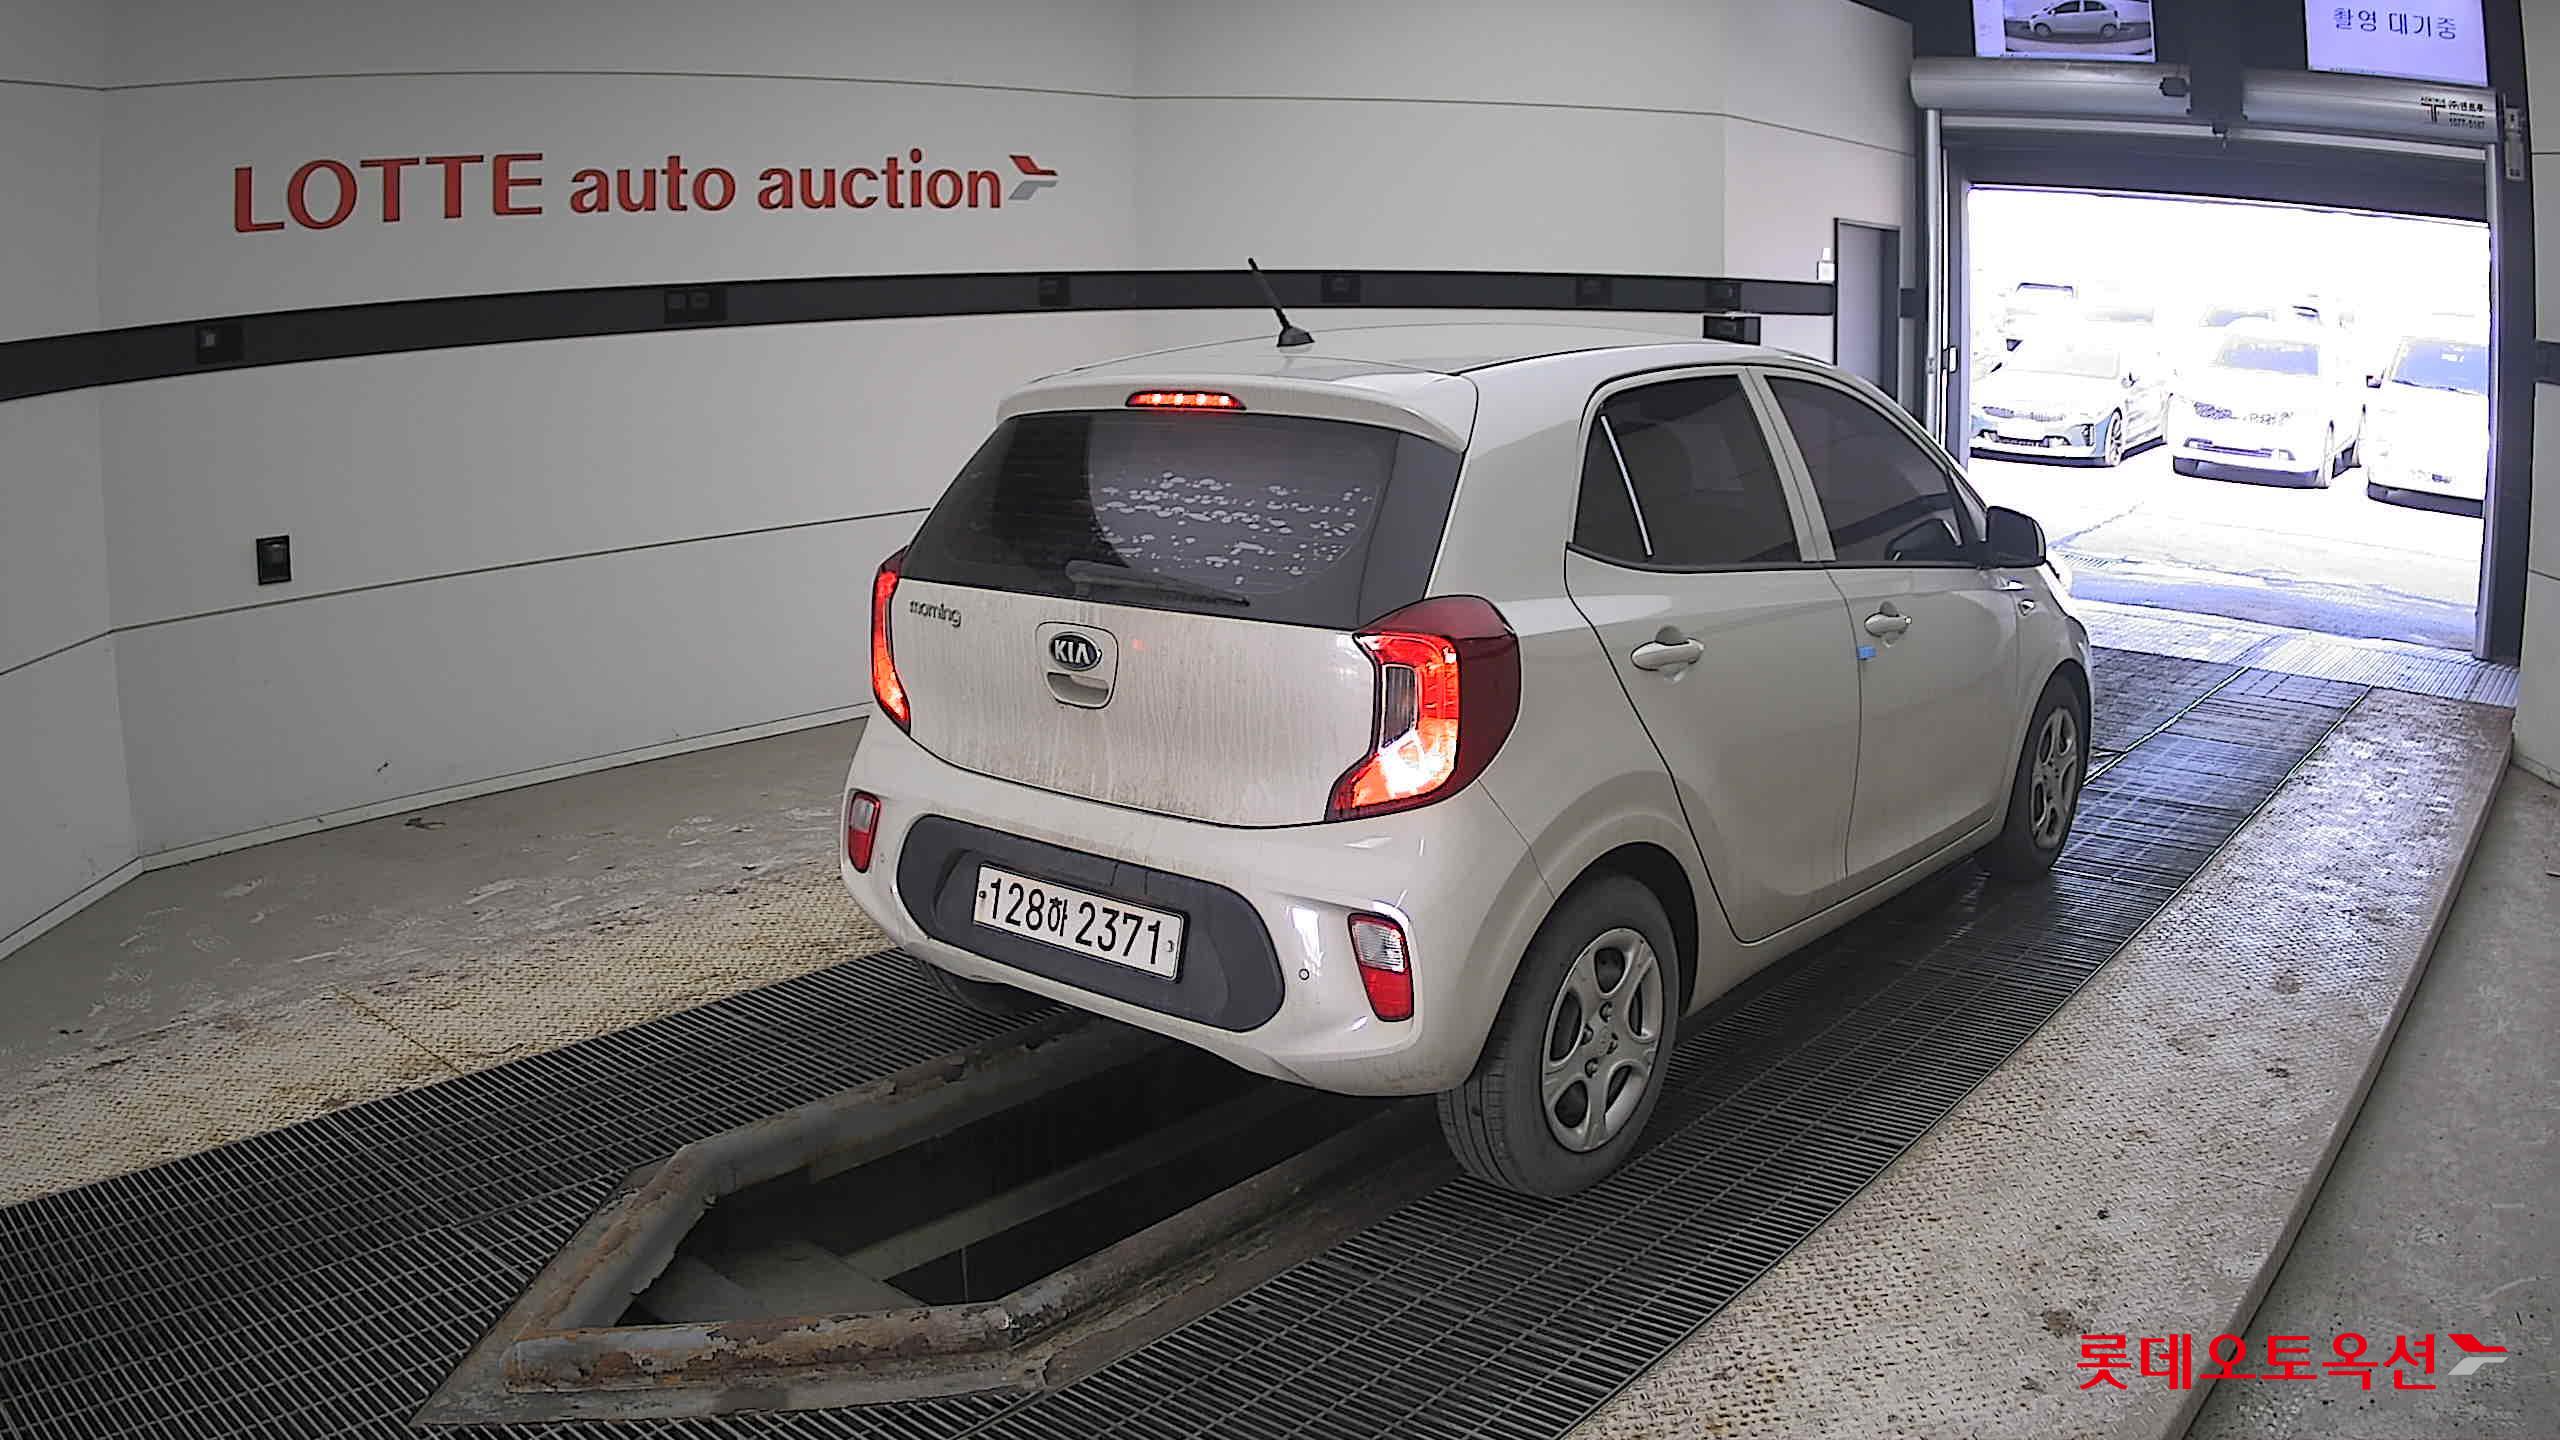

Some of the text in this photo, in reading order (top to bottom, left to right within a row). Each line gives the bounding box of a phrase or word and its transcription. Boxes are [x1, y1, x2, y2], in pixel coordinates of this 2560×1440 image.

[2333, 7, 2457, 40] 촬영 대기중
[235, 147, 1003, 233] LOTTE auto auction
[910, 601, 962, 628] morning
[1054, 639, 1091, 665] KIA
[990, 878, 1162, 965] 128하 2371
